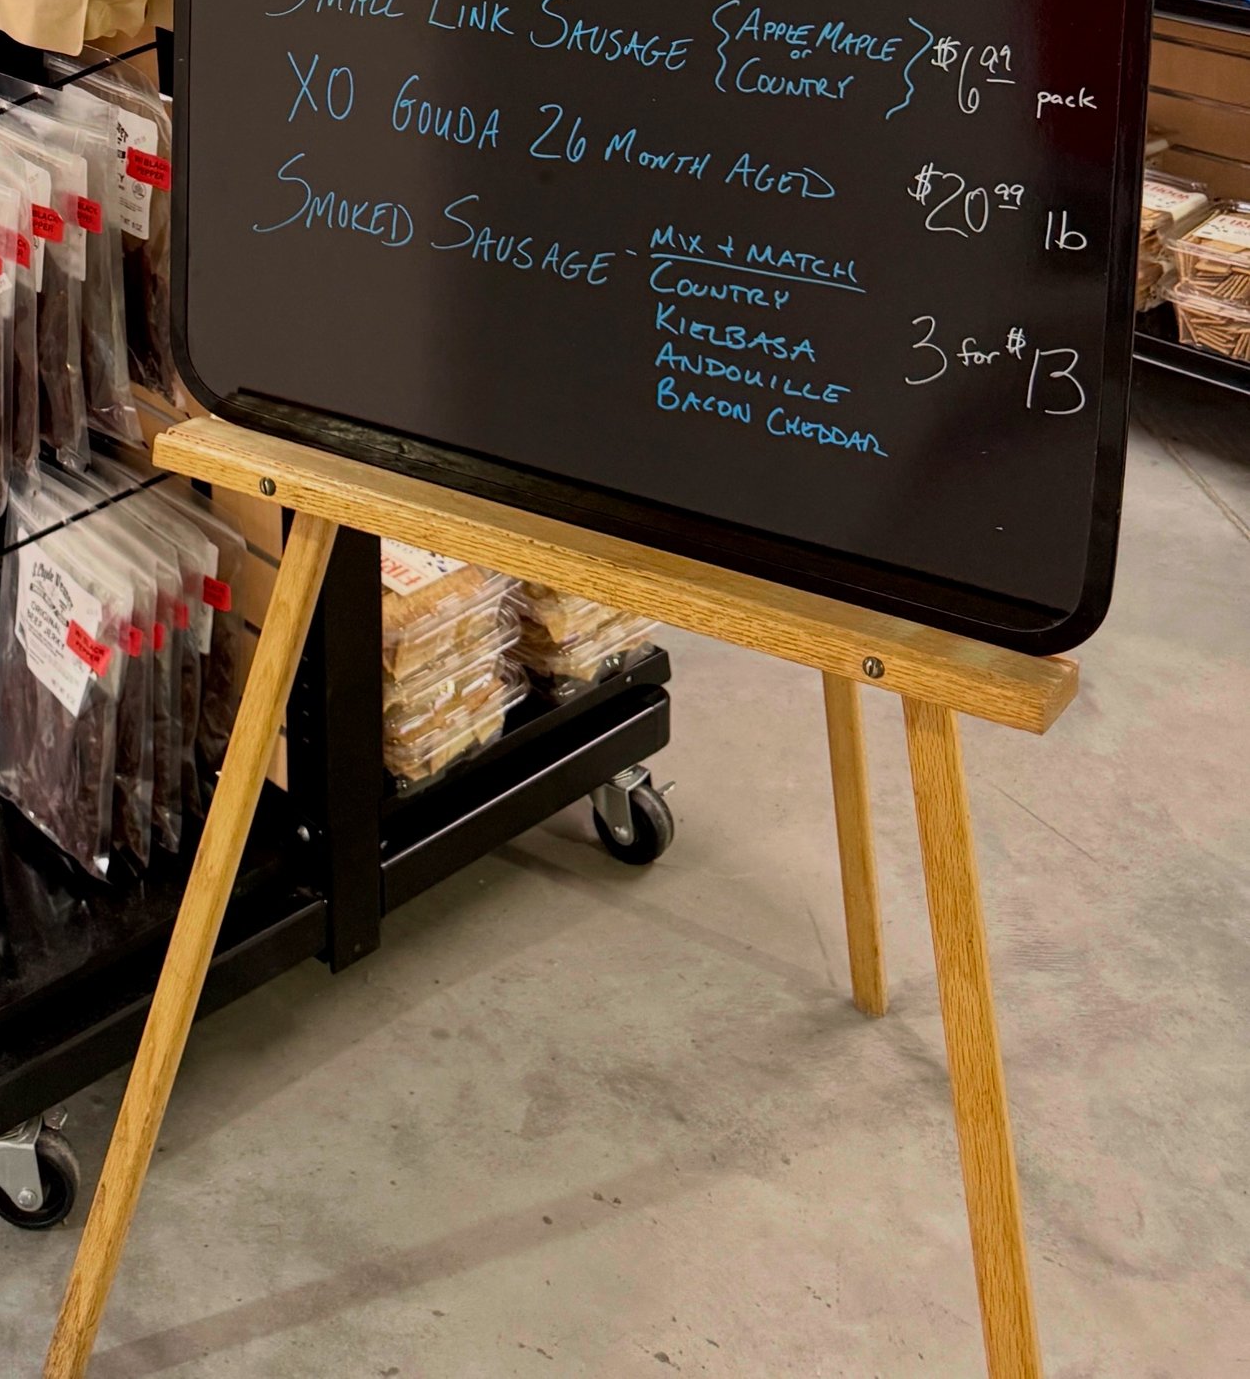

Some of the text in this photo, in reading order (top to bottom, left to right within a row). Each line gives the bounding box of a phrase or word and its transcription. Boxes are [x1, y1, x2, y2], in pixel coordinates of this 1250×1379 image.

[735, 7, 903, 64] APPLE MAPLE
[790, 48, 813, 60] or
[736, 57, 855, 100] COUNTRY
[1036, 87, 1098, 119] pack
[287, 51, 837, 200] XO GOUDA 26 MONTH AGED
[252, 152, 617, 286] SMOKED SAUSAGE
[649, 260, 790, 310] COUNTRY
[650, 225, 705, 255] MIX
[747, 243, 858, 285] MATCH
[656, 302, 818, 364] KIELBASA
[904, 315, 949, 386] 3
[957, 337, 1001, 368] for
[654, 341, 852, 405] ANDOUILLE
[657, 378, 890, 459] BACON CHEDDAR
